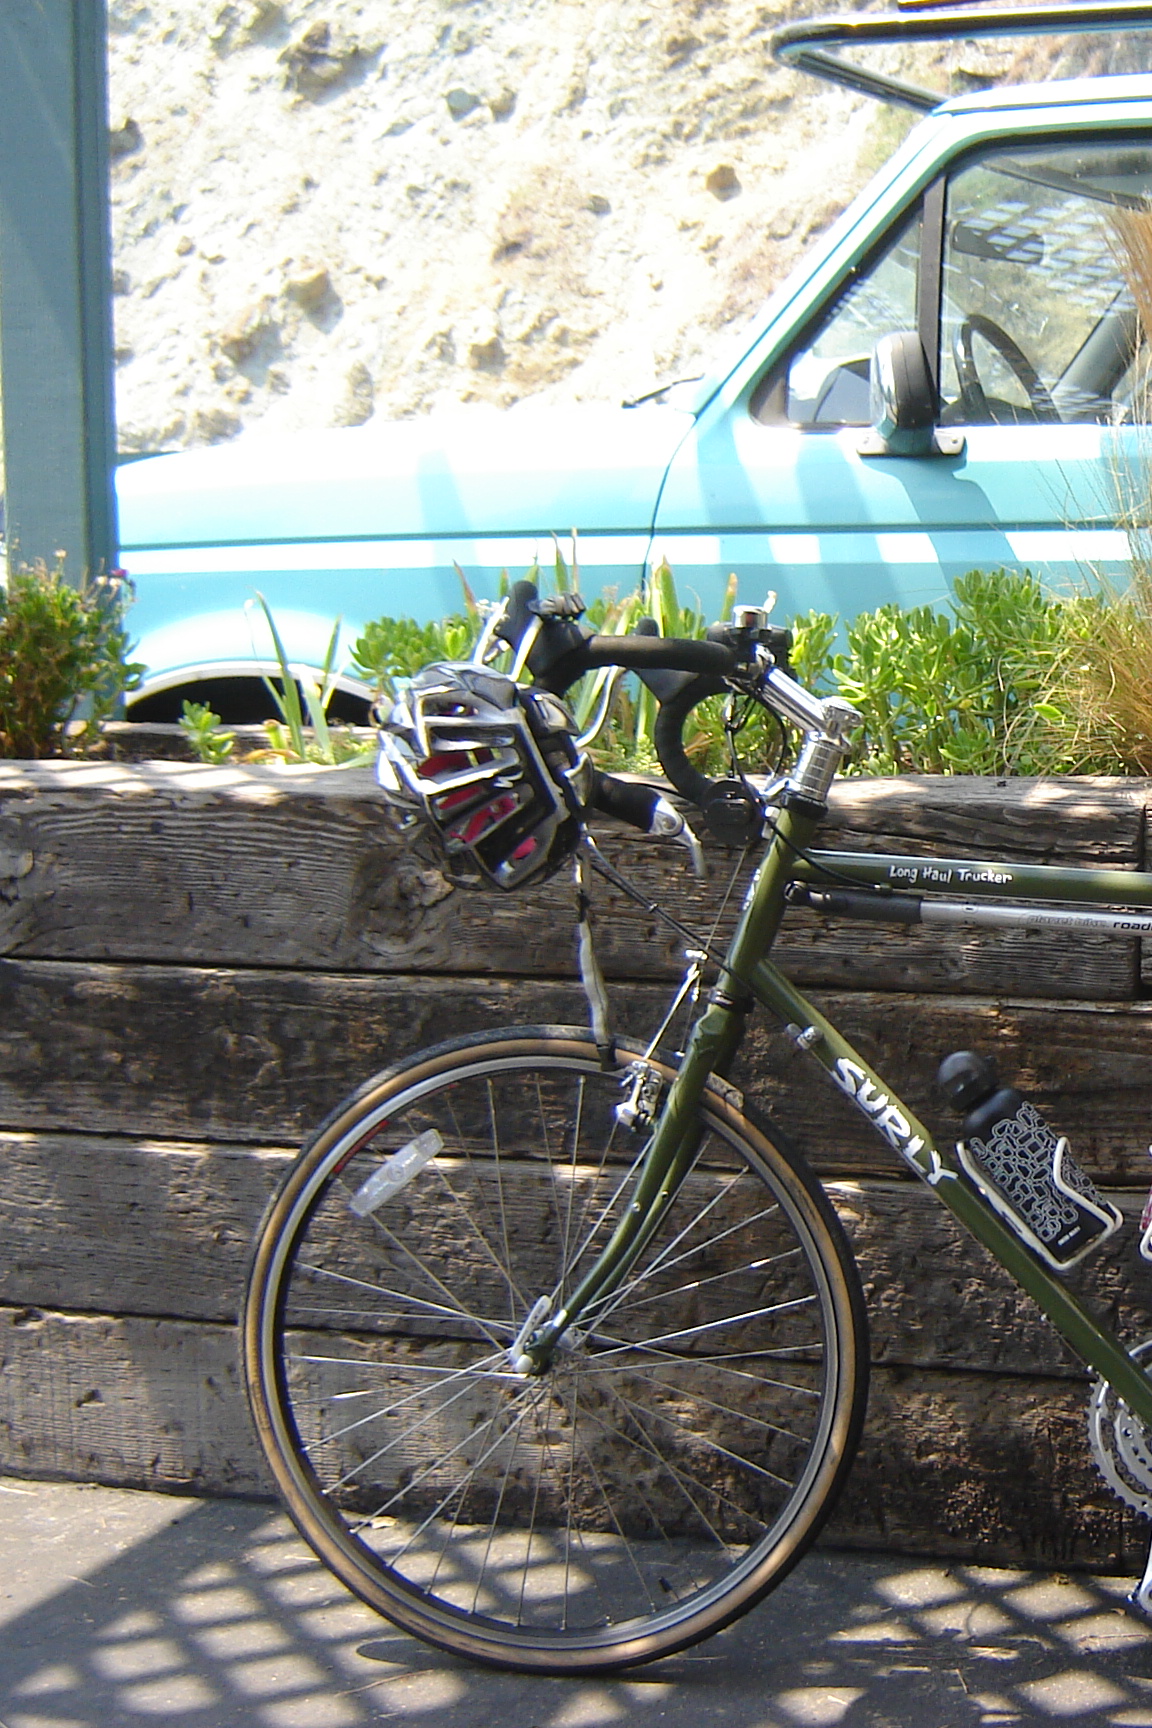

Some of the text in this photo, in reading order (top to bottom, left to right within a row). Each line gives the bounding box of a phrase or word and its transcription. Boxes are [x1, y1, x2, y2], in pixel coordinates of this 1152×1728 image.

[889, 865, 1013, 884] Long Haul Trucker
[830, 1056, 959, 1186] SURLY
